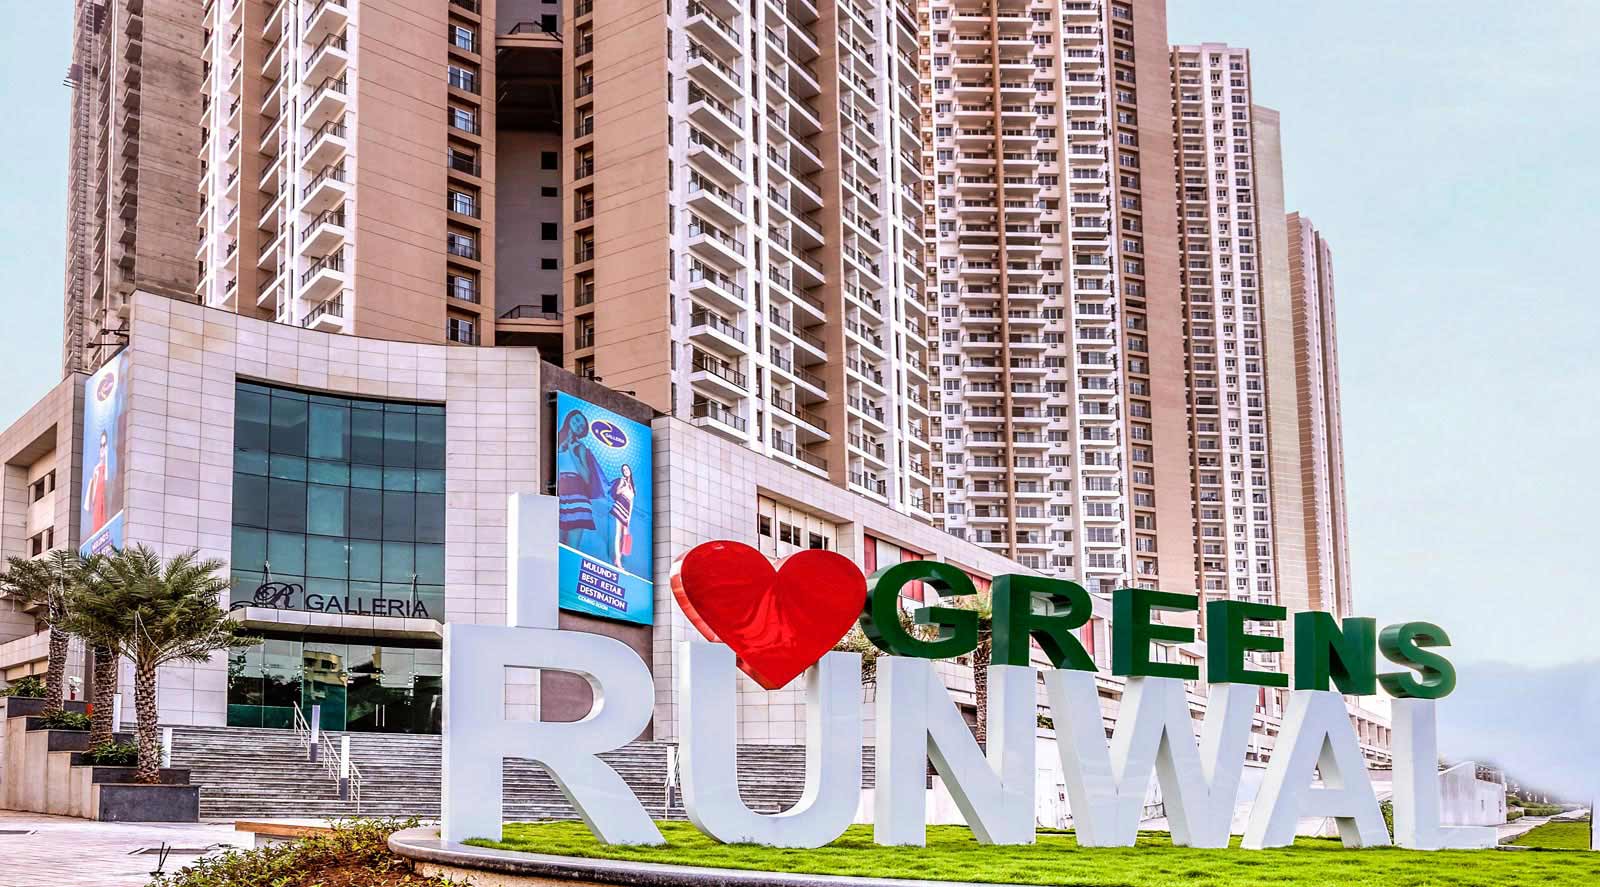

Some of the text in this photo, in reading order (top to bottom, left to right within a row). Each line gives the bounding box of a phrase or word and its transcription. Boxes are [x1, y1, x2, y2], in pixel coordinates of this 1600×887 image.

[583, 560, 618, 581] MULUND'S
[507, 493, 1456, 700] I GREENS
[579, 584, 627, 609] DESTINATION
[581, 572, 624, 597] BEST RETAIL
[306, 593, 429, 618] GALLERIA
[441, 623, 1497, 850] RUNWAL
